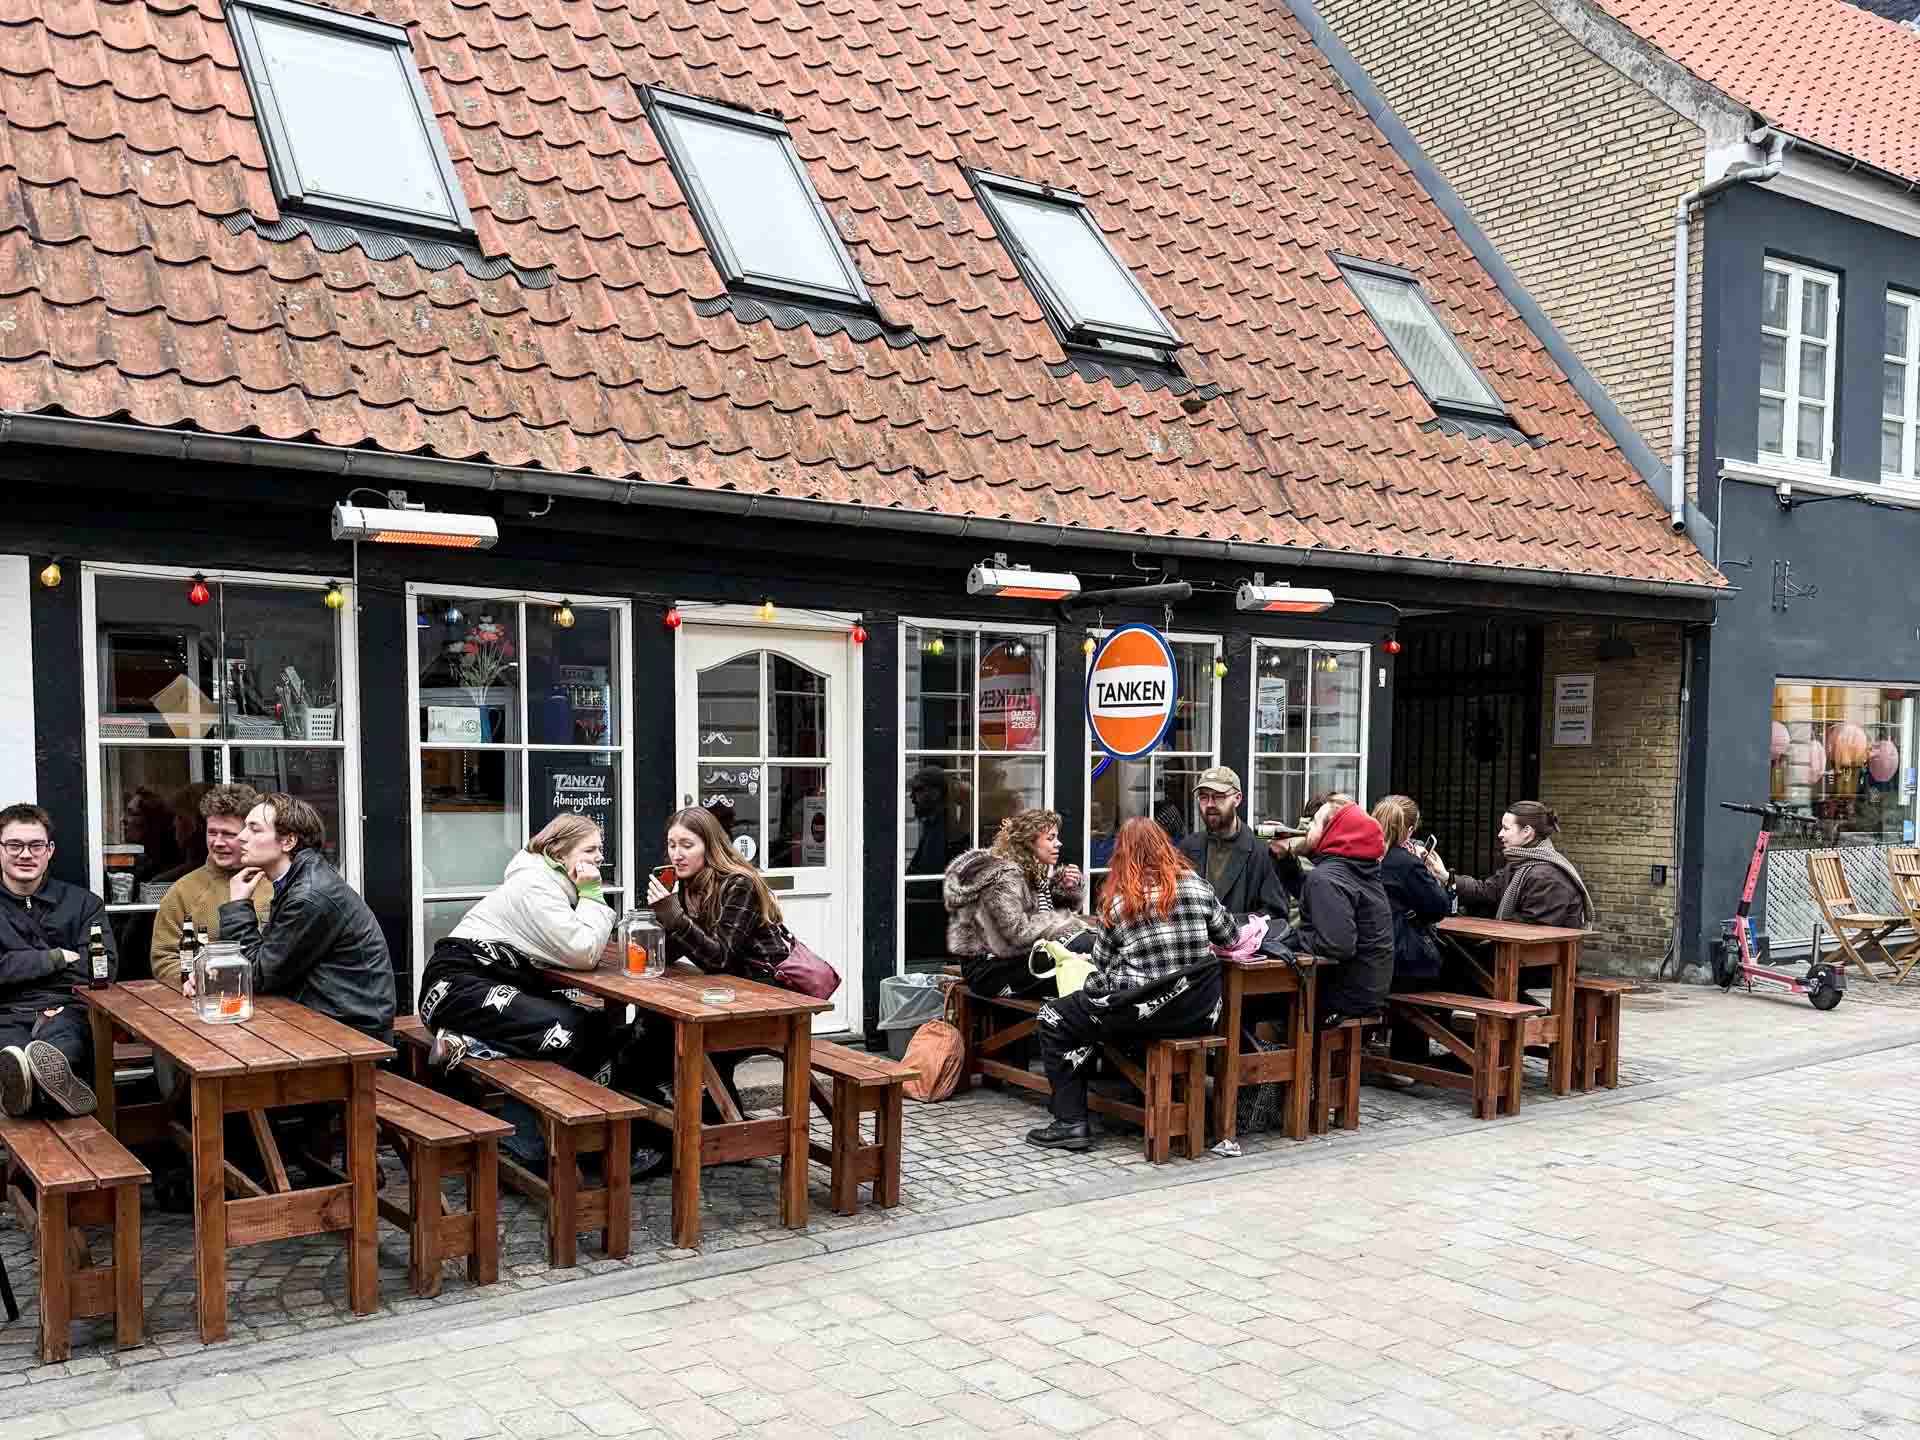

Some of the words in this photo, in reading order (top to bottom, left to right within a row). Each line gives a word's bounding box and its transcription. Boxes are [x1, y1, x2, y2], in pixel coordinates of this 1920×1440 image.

[1096, 680, 1166, 708] TANKEN
[1011, 721, 1036, 729] 2026
[553, 774, 605, 792] TANKEN
[553, 792, 612, 812] Åbningstider
